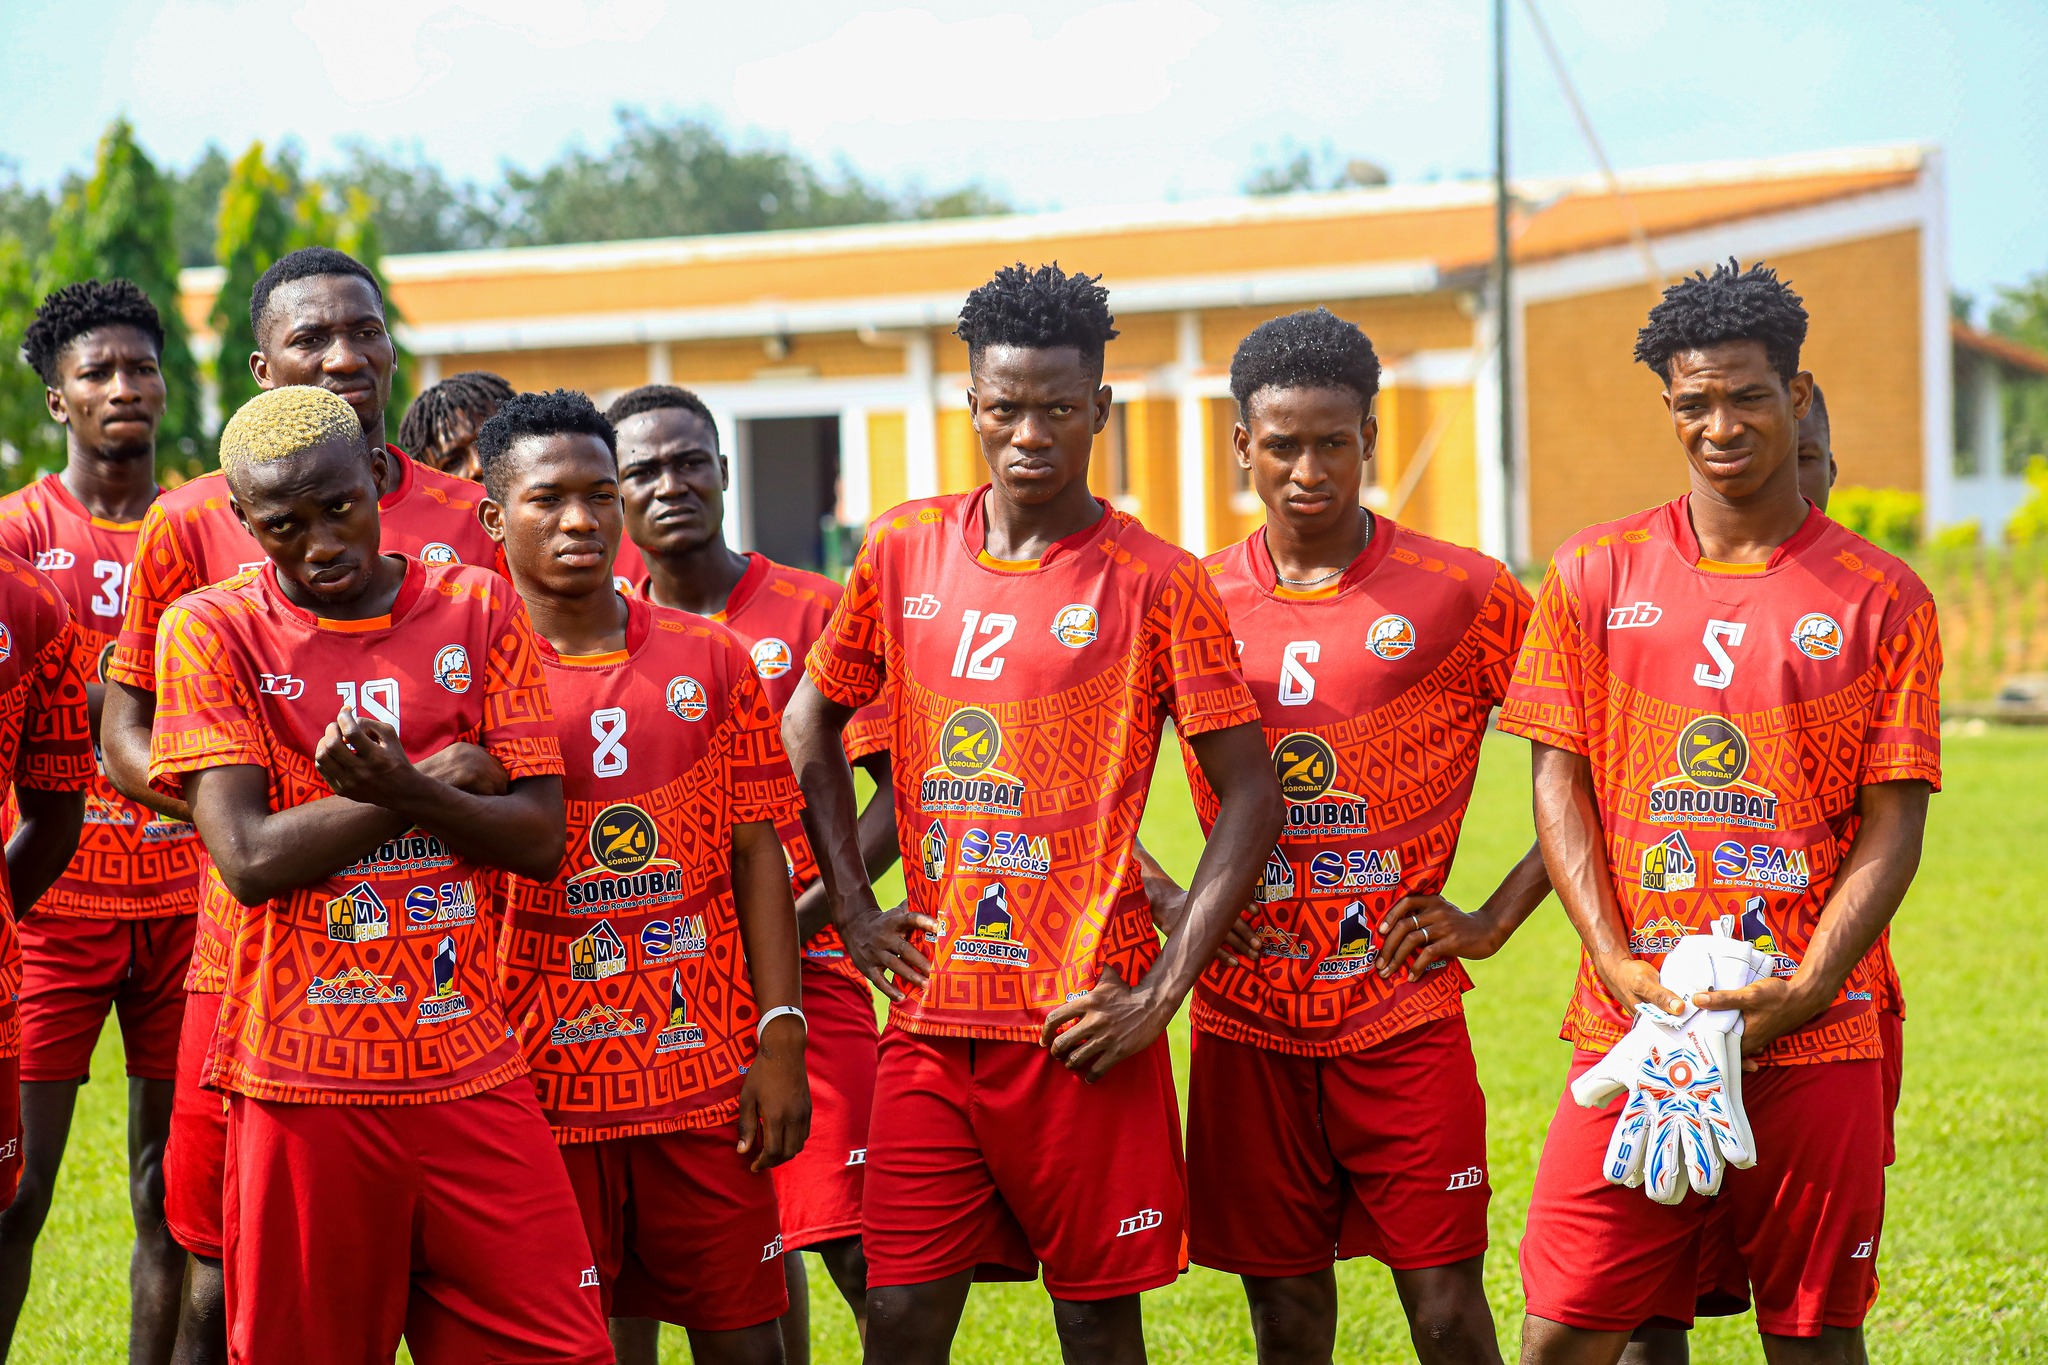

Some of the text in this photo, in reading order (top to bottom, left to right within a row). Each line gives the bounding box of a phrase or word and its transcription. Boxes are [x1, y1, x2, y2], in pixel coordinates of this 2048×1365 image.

[951, 609, 1017, 681] 12
[1693, 619, 1747, 689] 5
[1278, 640, 1321, 706] 6
[590, 706, 628, 779] 8
[948, 760, 983, 769] SOROUBAT
[1690, 769, 1733, 779] SOROUBAT
[922, 779, 1024, 807] SOROUBAT
[1283, 785, 1322, 793] SOROUBAT
[1650, 790, 1777, 819] SOROUBAT
[994, 832, 1050, 861] SAM
[607, 855, 646, 866] SOROUBAT
[986, 854, 1049, 873] MOTORS
[1347, 850, 1400, 873] SAM
[1751, 845, 1809, 875] SAM
[566, 869, 682, 906] SOROUBAT
[1344, 872, 1400, 886] MOTORS
[1746, 869, 1808, 887] MOTORS
[307, 986, 405, 999] SOGECAR
[551, 1017, 644, 1040] SOGECAR
